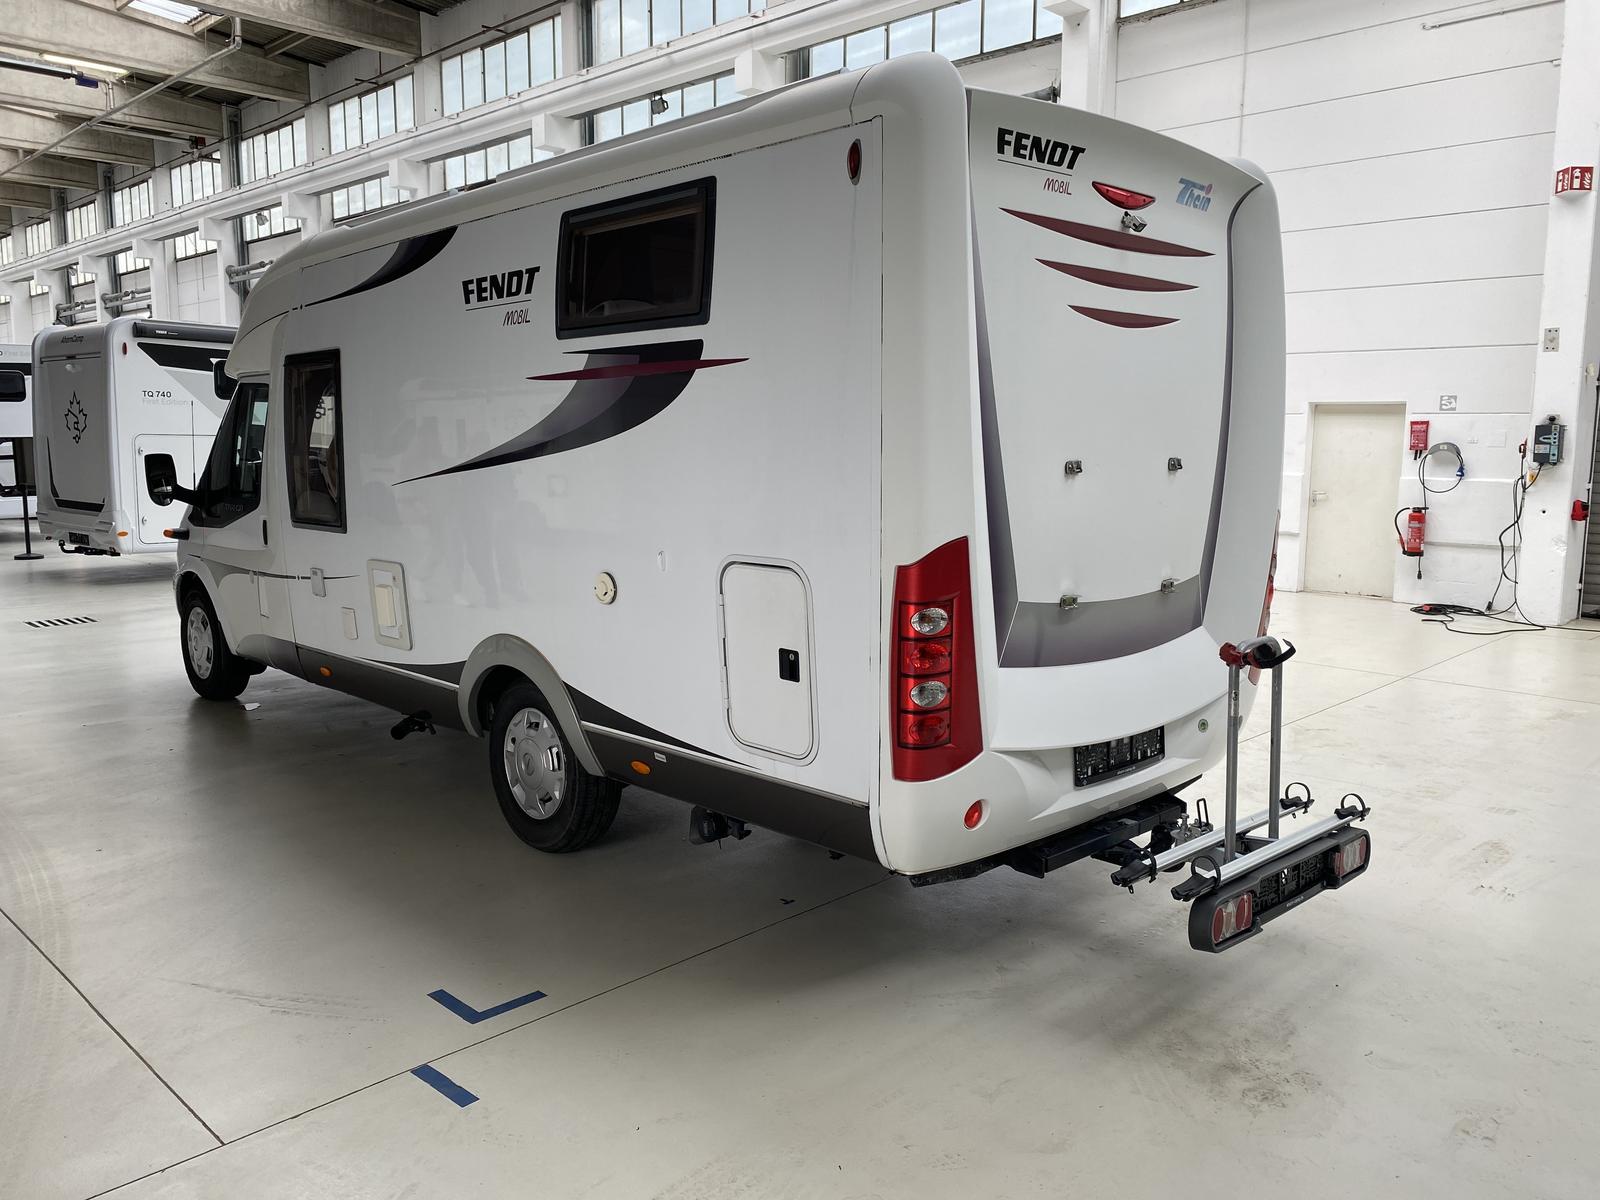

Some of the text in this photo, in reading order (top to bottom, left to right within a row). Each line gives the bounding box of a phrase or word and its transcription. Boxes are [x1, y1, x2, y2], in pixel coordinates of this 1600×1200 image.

[997, 127, 1087, 171] FENDT
[1043, 177, 1073, 196] MOBIL
[462, 265, 541, 305] FENDT
[502, 308, 531, 327] MOBIL
[141, 390, 172, 398] TQ 740
